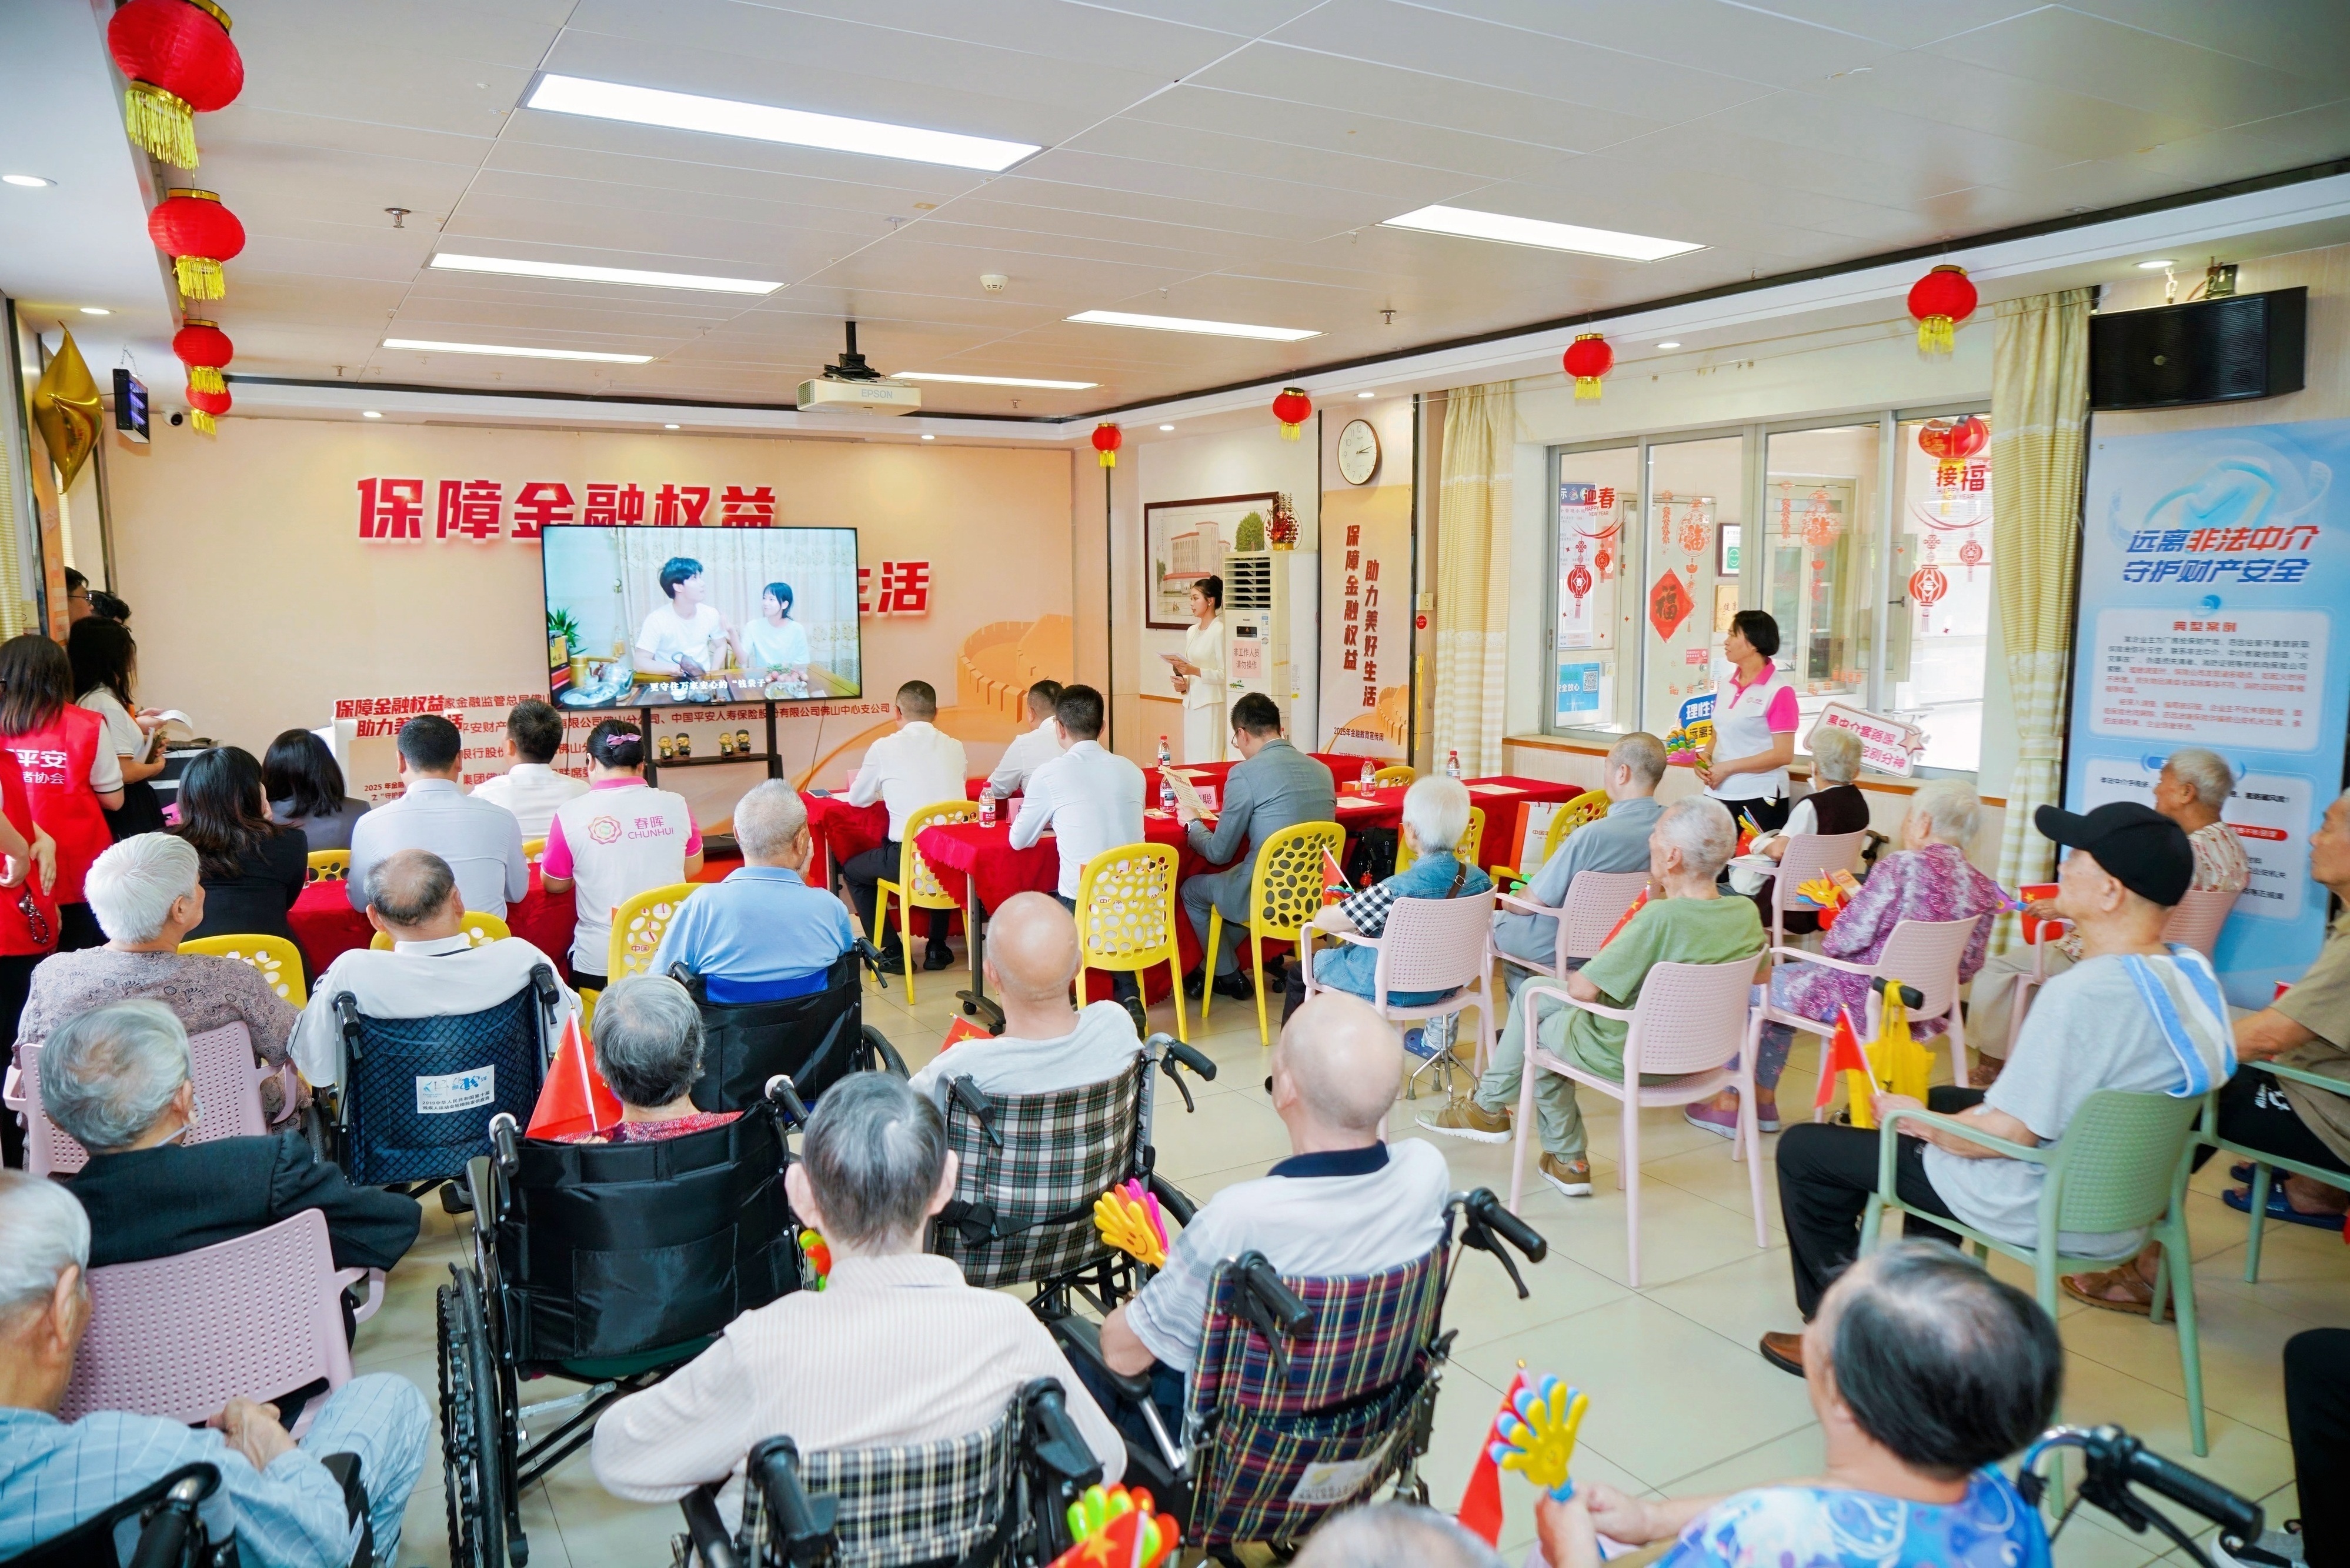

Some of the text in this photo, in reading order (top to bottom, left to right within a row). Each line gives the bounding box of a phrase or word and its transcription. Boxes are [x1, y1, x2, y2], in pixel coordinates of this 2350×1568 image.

[861, 389, 893, 399] EPSON
[1936, 465, 1985, 492] 接福
[357, 477, 776, 539] 保障金融权益
[1583, 487, 1615, 509] 迎春
[1684, 524, 1705, 551] 福
[2126, 525, 2320, 553] 远离非法中介
[2123, 558, 2311, 583] 守护财产安全
[859, 560, 930, 615] 活
[1575, 578, 1583, 587] 春
[1343, 525, 1360, 670] 保障金融权益
[1655, 585, 1679, 620] 福
[1362, 559, 1380, 707] 助力美好生活
[2172, 621, 2238, 632] 典型案例
[1233, 648, 1260, 658] 非工作人员
[1236, 660, 1257, 670] 请勿操作
[650, 679, 727, 692] 更守住万家安心的
[335, 695, 445, 719] 保障金融权益
[1333, 726, 1384, 742] 2025年金融教育宣传周
[5, 748, 67, 769] 平安
[627, 827, 674, 839] CHUNHUI
[634, 815, 665, 830] 春晖
[422, 1090, 490, 1105] 2019中华人民共和国第十届
